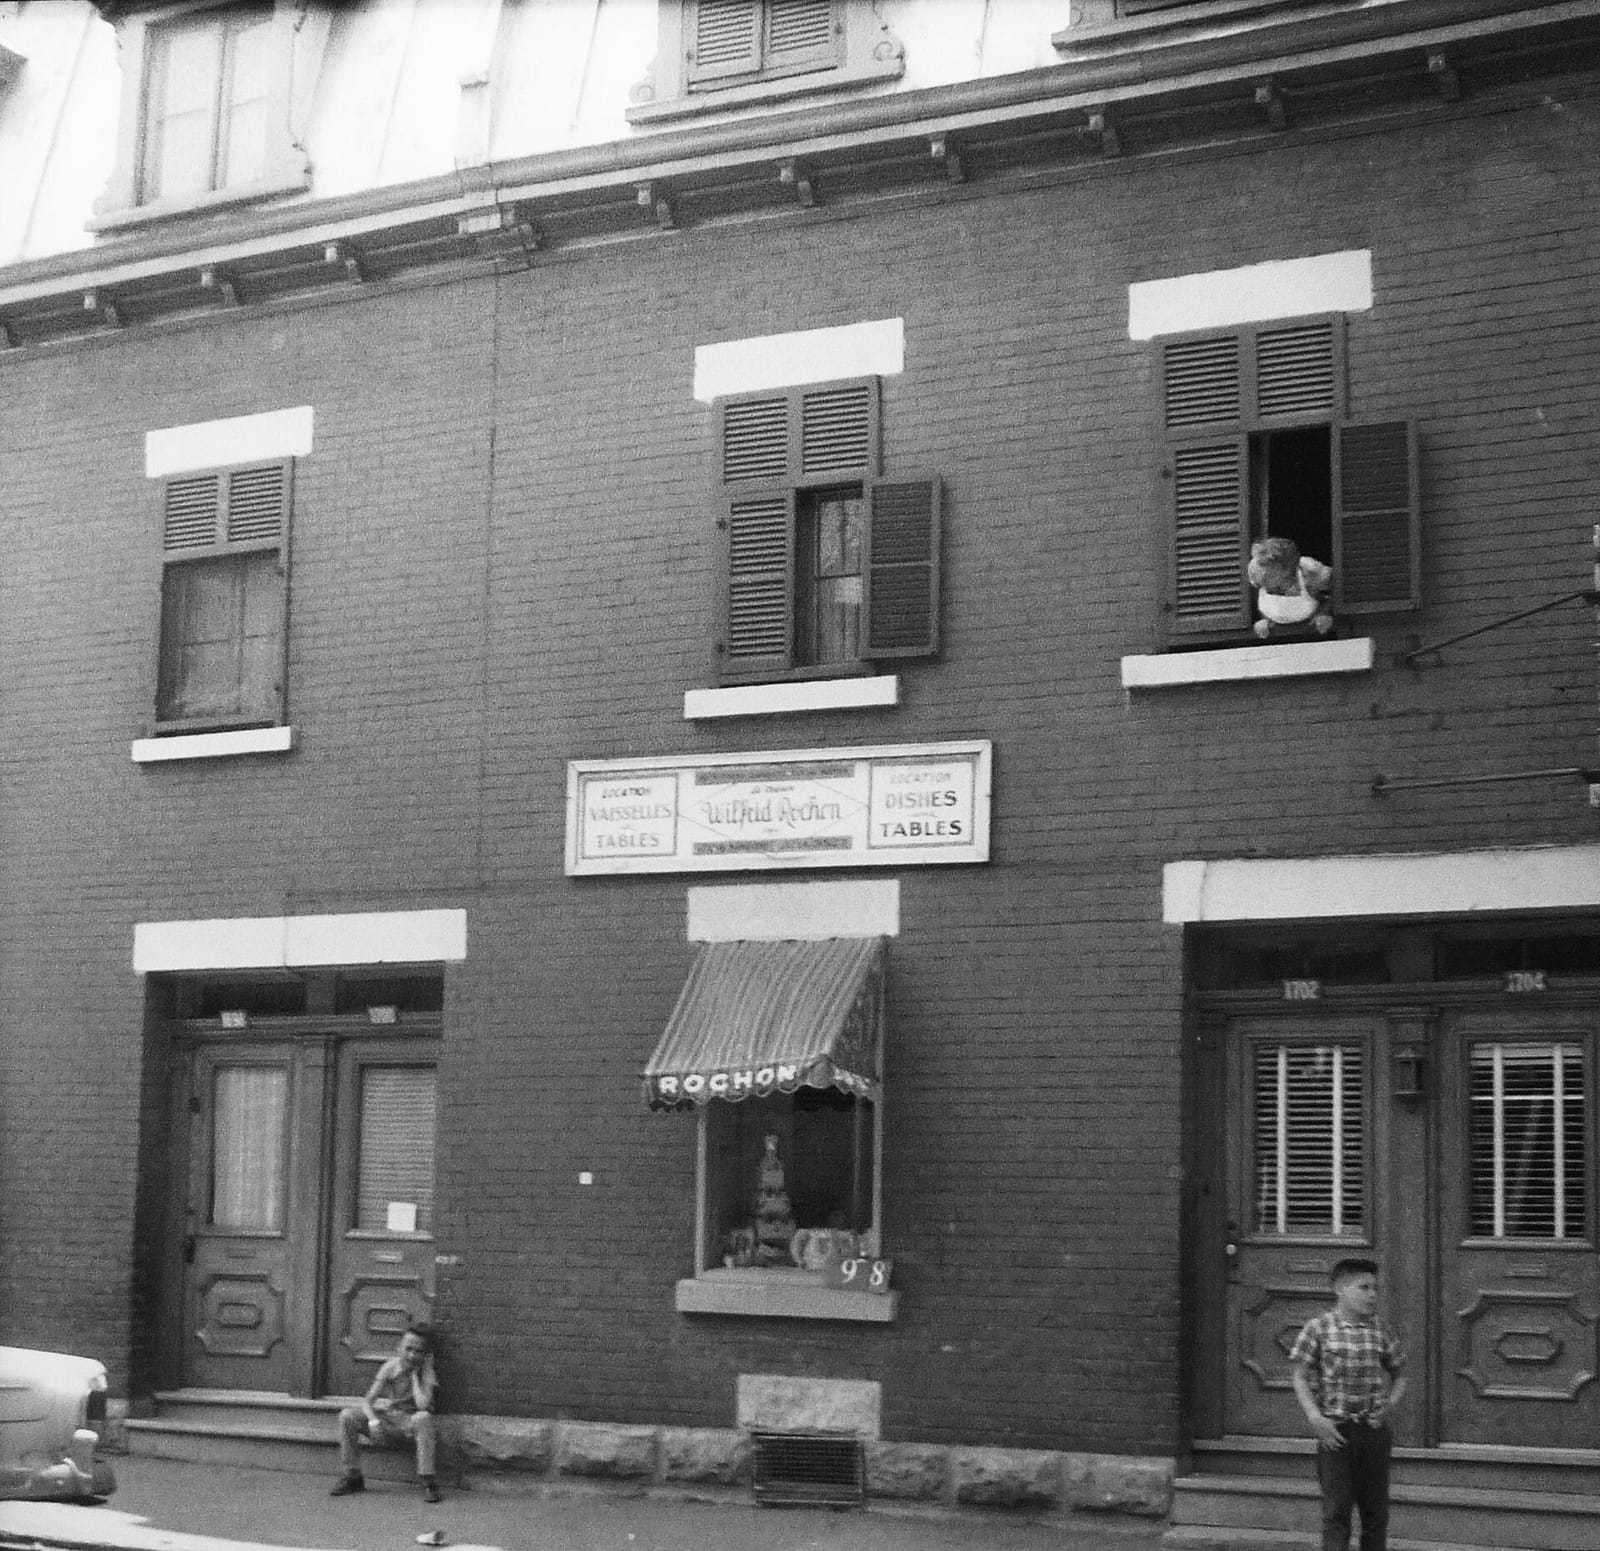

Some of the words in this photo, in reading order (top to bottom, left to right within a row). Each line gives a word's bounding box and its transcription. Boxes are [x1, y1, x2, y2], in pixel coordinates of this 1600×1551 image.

[885, 790, 958, 808] DISHES
[590, 804, 673, 822] VAISSELLES
[880, 820, 963, 838] TABLES
[596, 832, 660, 849] TABLES
[659, 1065, 797, 1094] ROCHON
